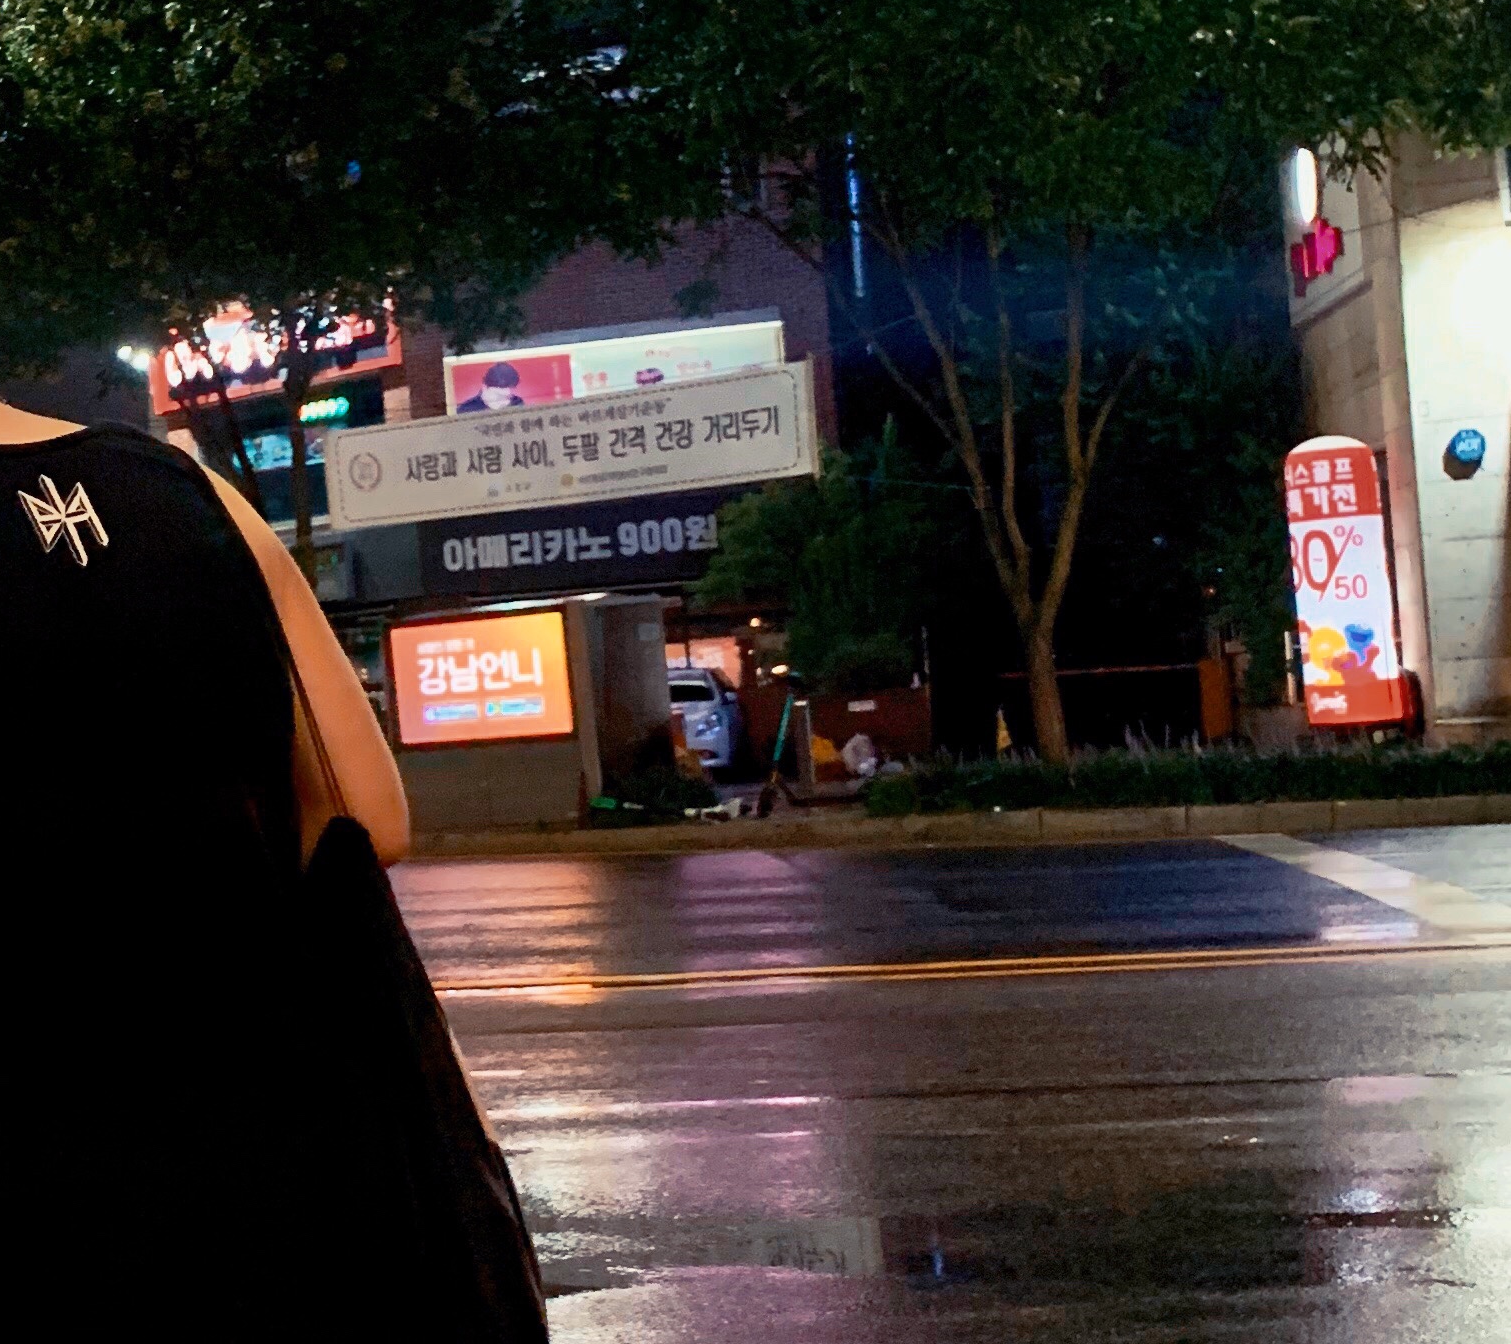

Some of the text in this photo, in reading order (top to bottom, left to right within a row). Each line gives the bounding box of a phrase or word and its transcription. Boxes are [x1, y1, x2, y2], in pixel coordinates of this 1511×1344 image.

[466, 444, 502, 474] 사람
[562, 432, 600, 463] 두팔
[608, 424, 646, 458] 간격
[654, 418, 694, 451] 건강
[702, 405, 780, 443] 거리두기
[442, 513, 719, 572] 아메리카노 900원
[1334, 574, 1368, 601] 50
[417, 647, 544, 695] 강남언니
